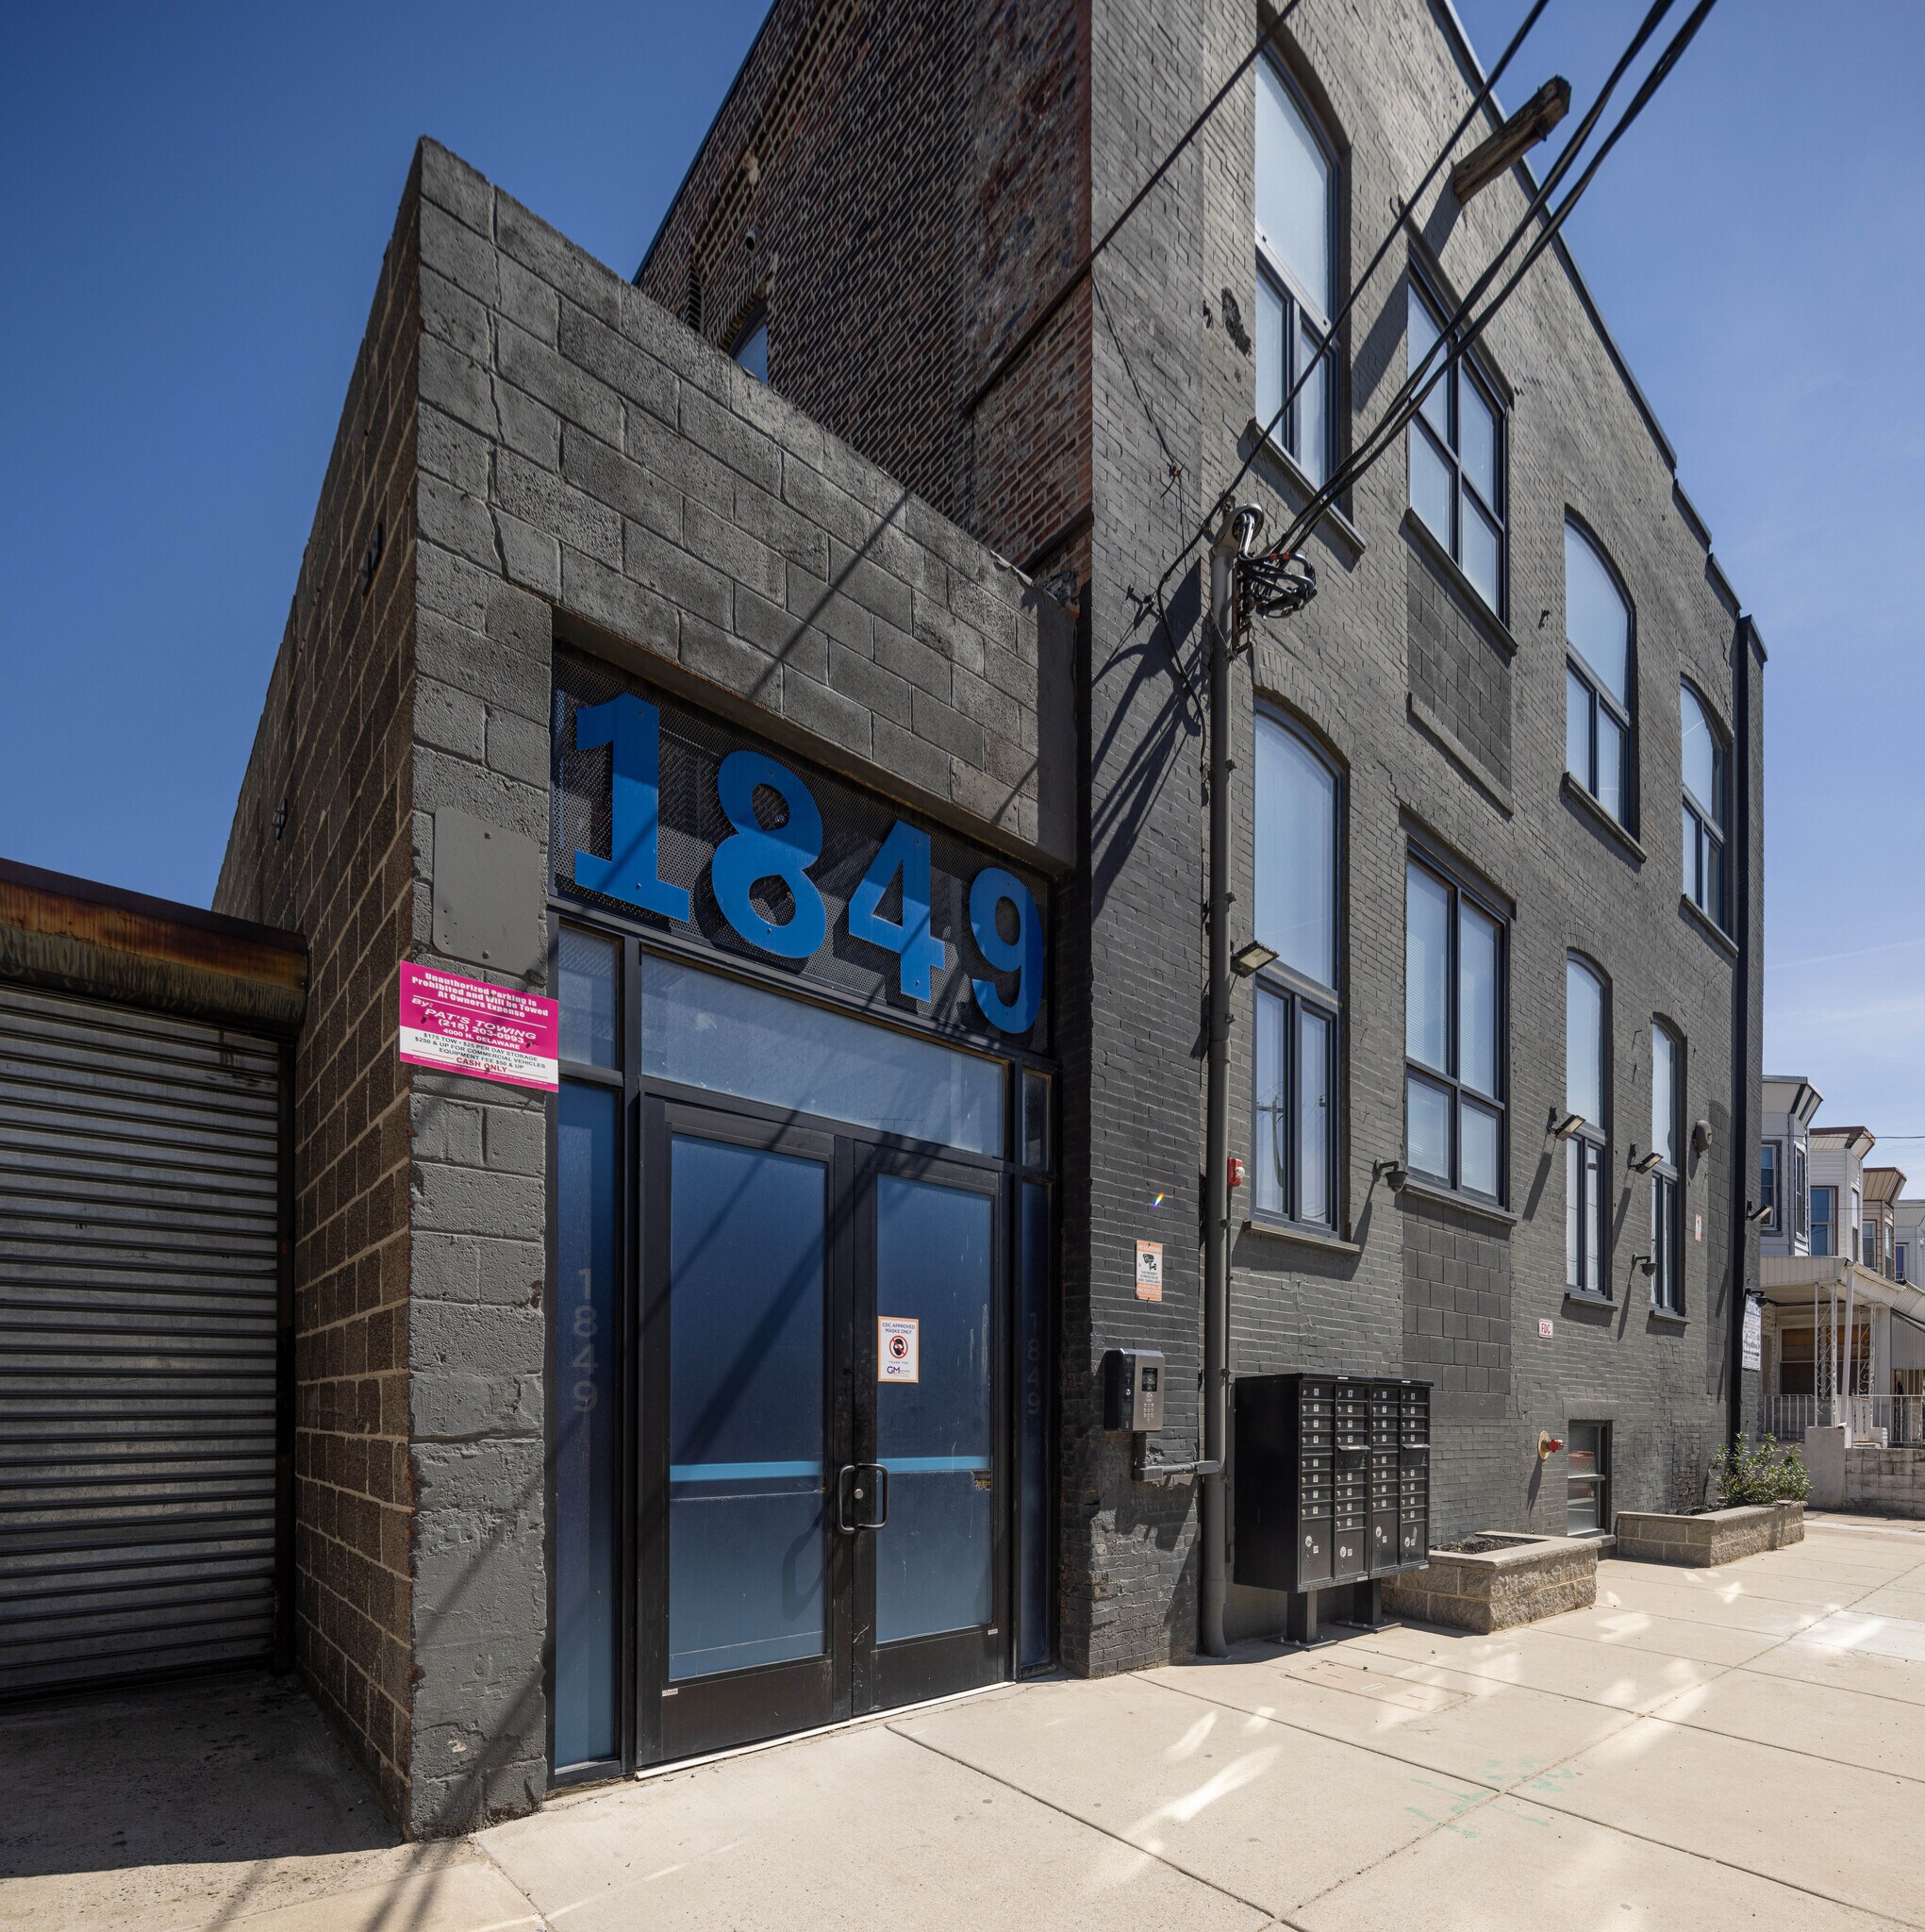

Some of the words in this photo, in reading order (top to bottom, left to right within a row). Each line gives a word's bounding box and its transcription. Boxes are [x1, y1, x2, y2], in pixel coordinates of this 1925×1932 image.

[574, 692, 1043, 1034] 1849
[411, 976, 464, 995] Prohibited
[466, 991, 484, 1001] and
[486, 994, 505, 1006] Will
[506, 1000, 518, 1008] be
[520, 1003, 549, 1016] Towed
[411, 998, 433, 1008] By:
[425, 973, 490, 995] Unauthorized
[490, 990, 526, 1005] Parking
[438, 991, 448, 999] At
[450, 993, 486, 1008] Owners
[487, 1003, 525, 1018] Expense
[425, 1008, 471, 1024] PAT'S
[475, 1020, 537, 1040] TOWING
[439, 1019, 469, 1032] (215)
[473, 1026, 524, 1043] 203-0993
[415, 1036, 431, 1044] $250
[467, 1048, 512, 1061] COMMERCIAL
[513, 1058, 546, 1069] VEHICLES
[423, 1032, 440, 1041] $175
[506, 1051, 538, 1061] STORAGE
[439, 1047, 479, 1059] EQUIPMENT
[443, 1028, 463, 1037] 4000
[476, 1036, 521, 1050] DELAWARE
[456, 1057, 481, 1068] CASH
[484, 1063, 507, 1073] ONLY
[573, 1268, 599, 1412] 1849
[1541, 1323, 1551, 1334] FDC
[887, 1365, 900, 1374] GM
[1027, 1311, 1041, 1415] 1849
